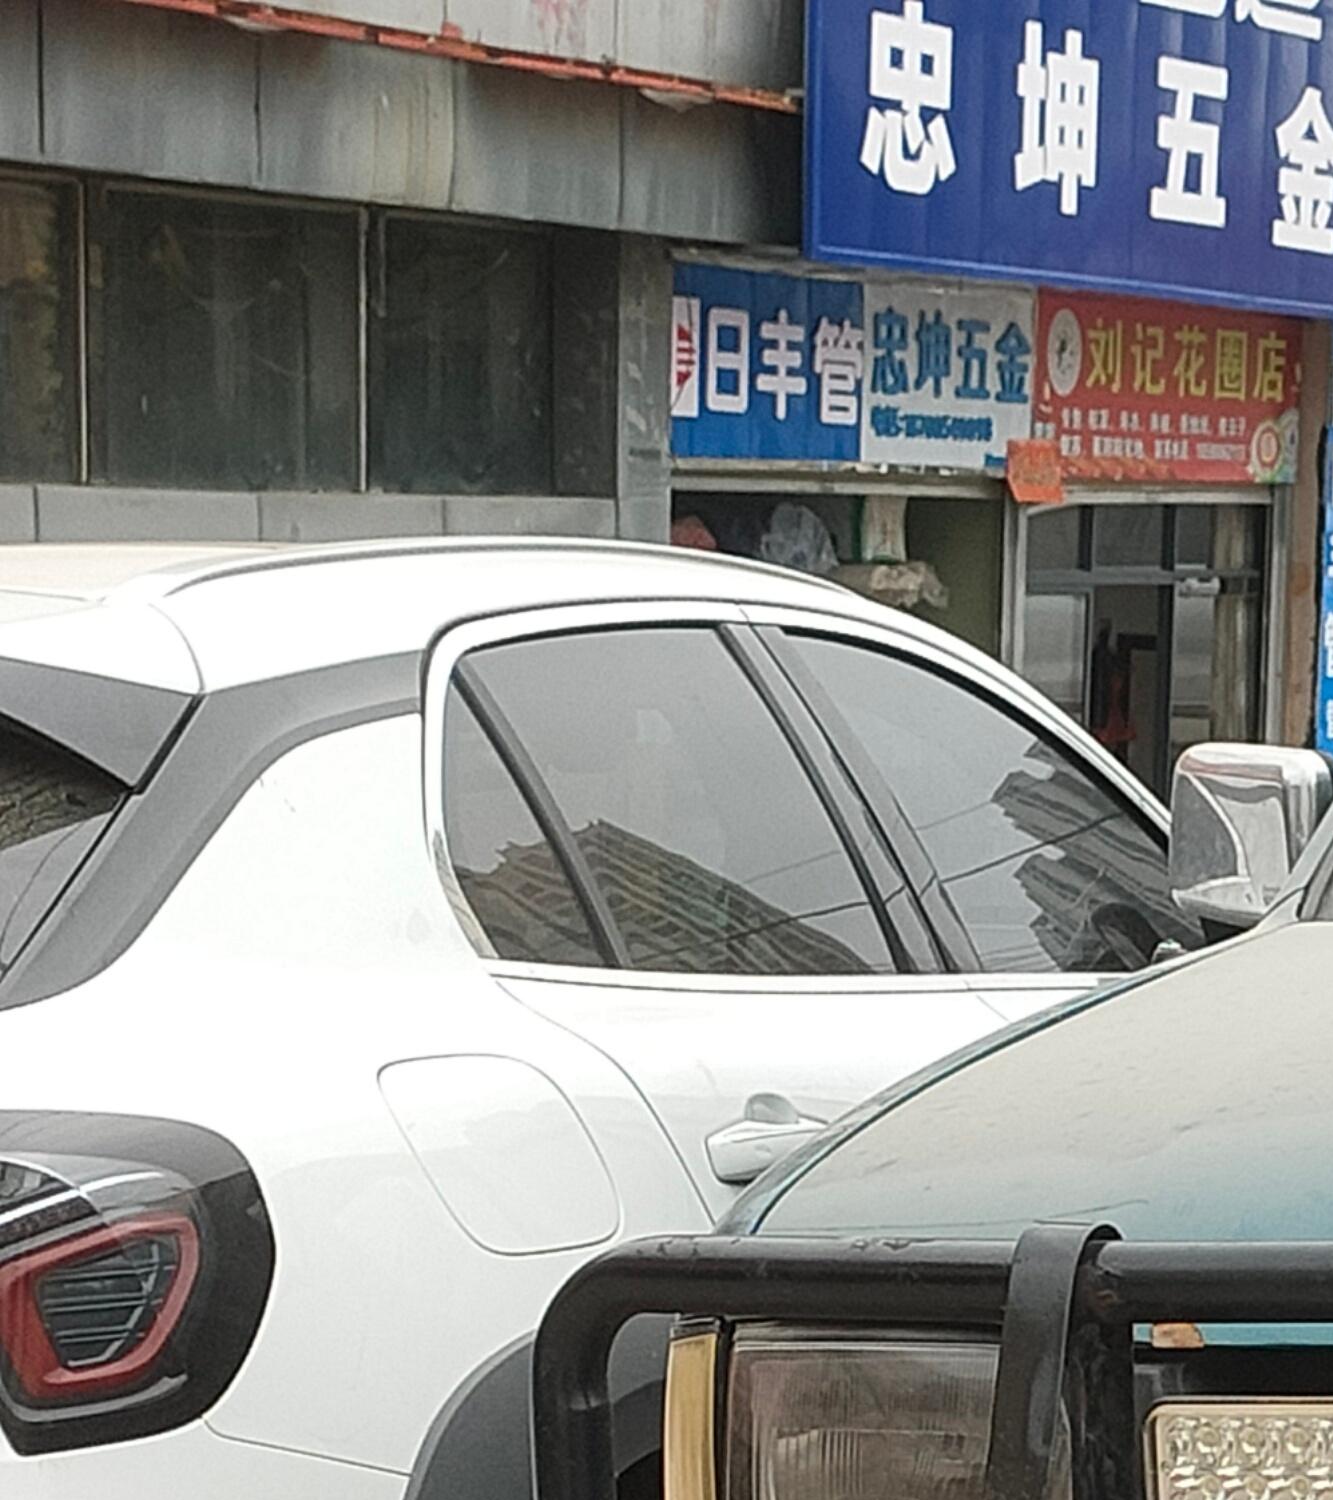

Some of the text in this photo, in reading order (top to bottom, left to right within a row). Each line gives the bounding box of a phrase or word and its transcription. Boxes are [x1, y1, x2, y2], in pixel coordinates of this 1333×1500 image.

[706, 306, 864, 426] 日丰管
[870, 305, 1033, 404] 忠坤五金
[1085, 318, 1287, 403] 刘记花圈店
